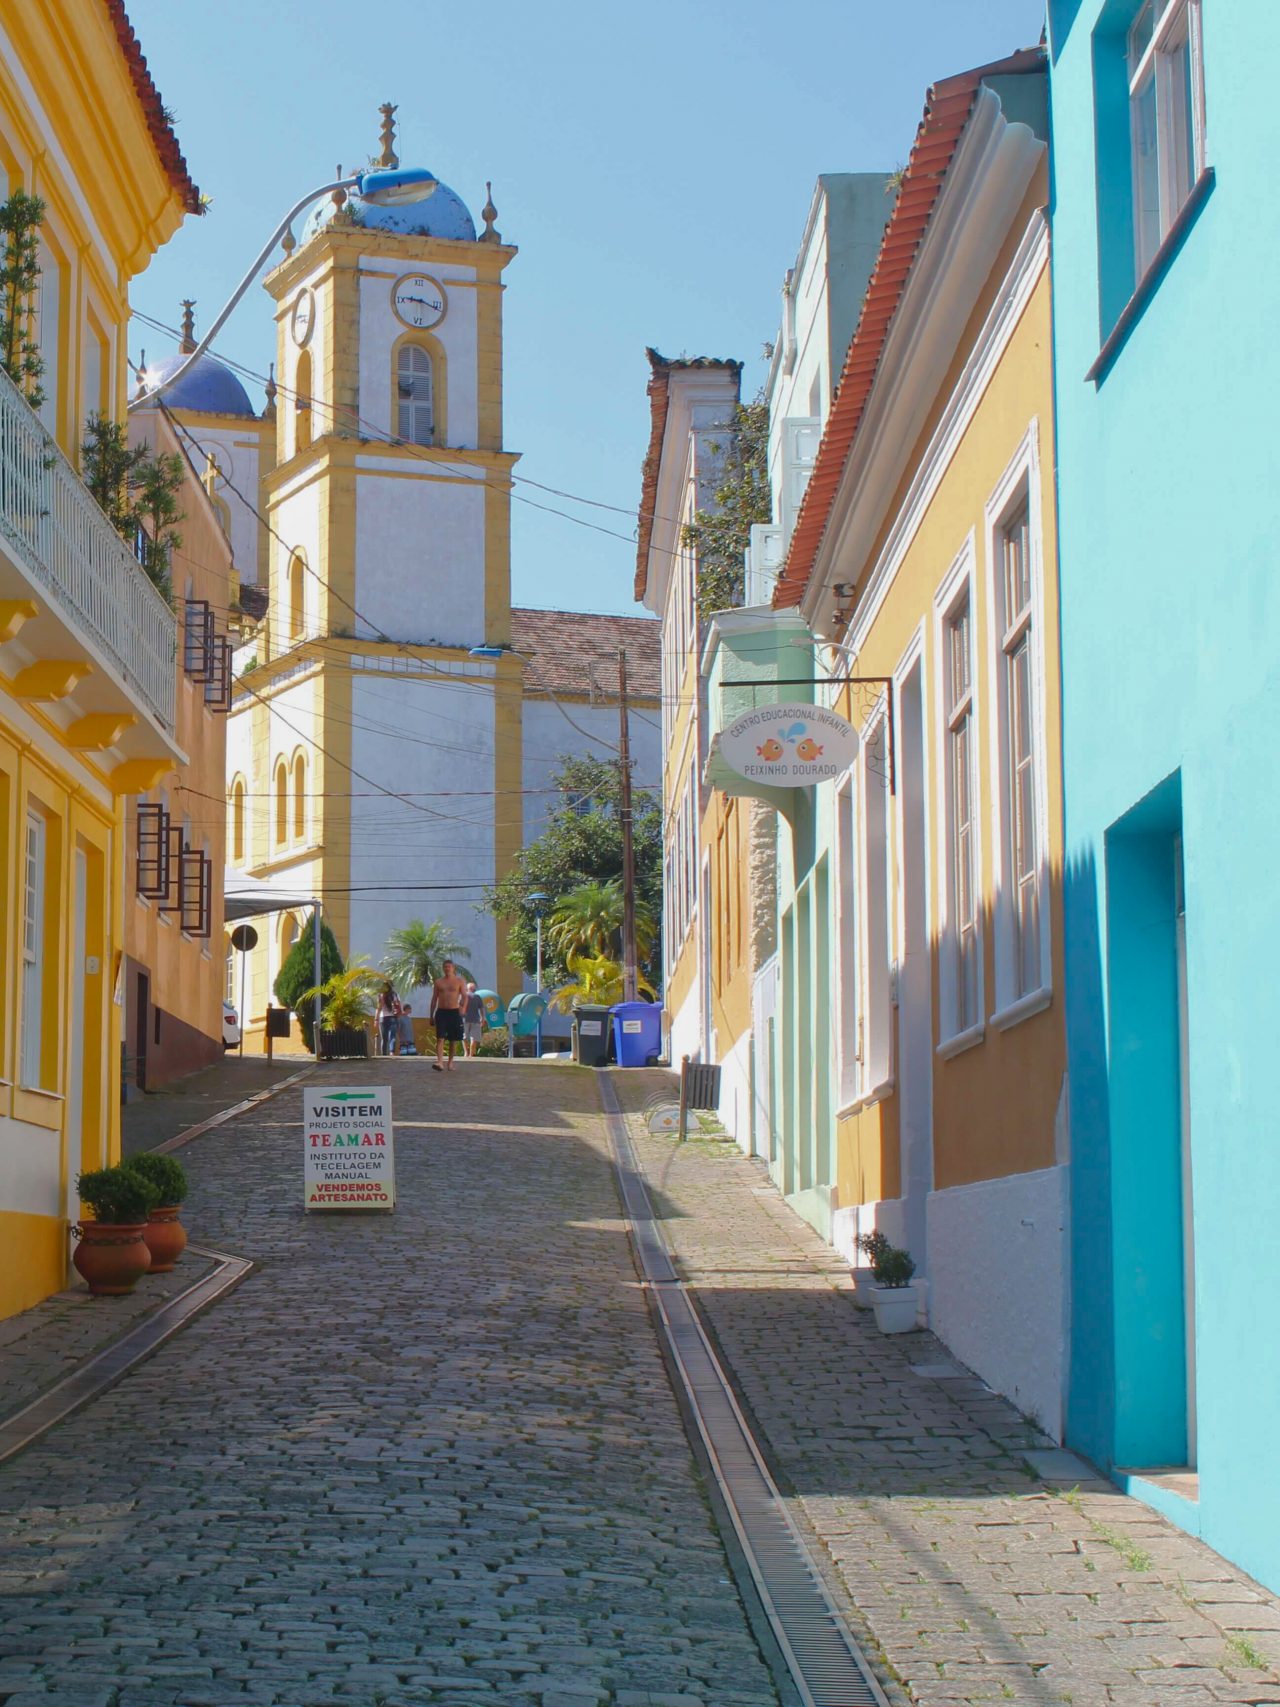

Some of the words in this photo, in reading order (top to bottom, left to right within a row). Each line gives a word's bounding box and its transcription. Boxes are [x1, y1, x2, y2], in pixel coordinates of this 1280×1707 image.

[730, 715, 761, 738] CENTRO
[761, 708, 816, 722] EDUCACIONAL
[817, 712, 851, 738] INFANTIL
[744, 764, 788, 776] PEIXINHO
[792, 764, 837, 775] DOURADO
[313, 1105, 382, 1118] VISITEM
[309, 1121, 350, 1129] PROJETO
[353, 1120, 385, 1129] SOCIAL
[309, 1133, 386, 1147] TEAMAR
[310, 1152, 367, 1161] INSTITUTO
[369, 1152, 385, 1160] DA
[314, 1162, 381, 1171] TECELAGEM
[324, 1172, 371, 1180] MANUAL
[316, 1183, 382, 1192] VENDEMOS
[309, 1193, 388, 1202] ARTESANATO
